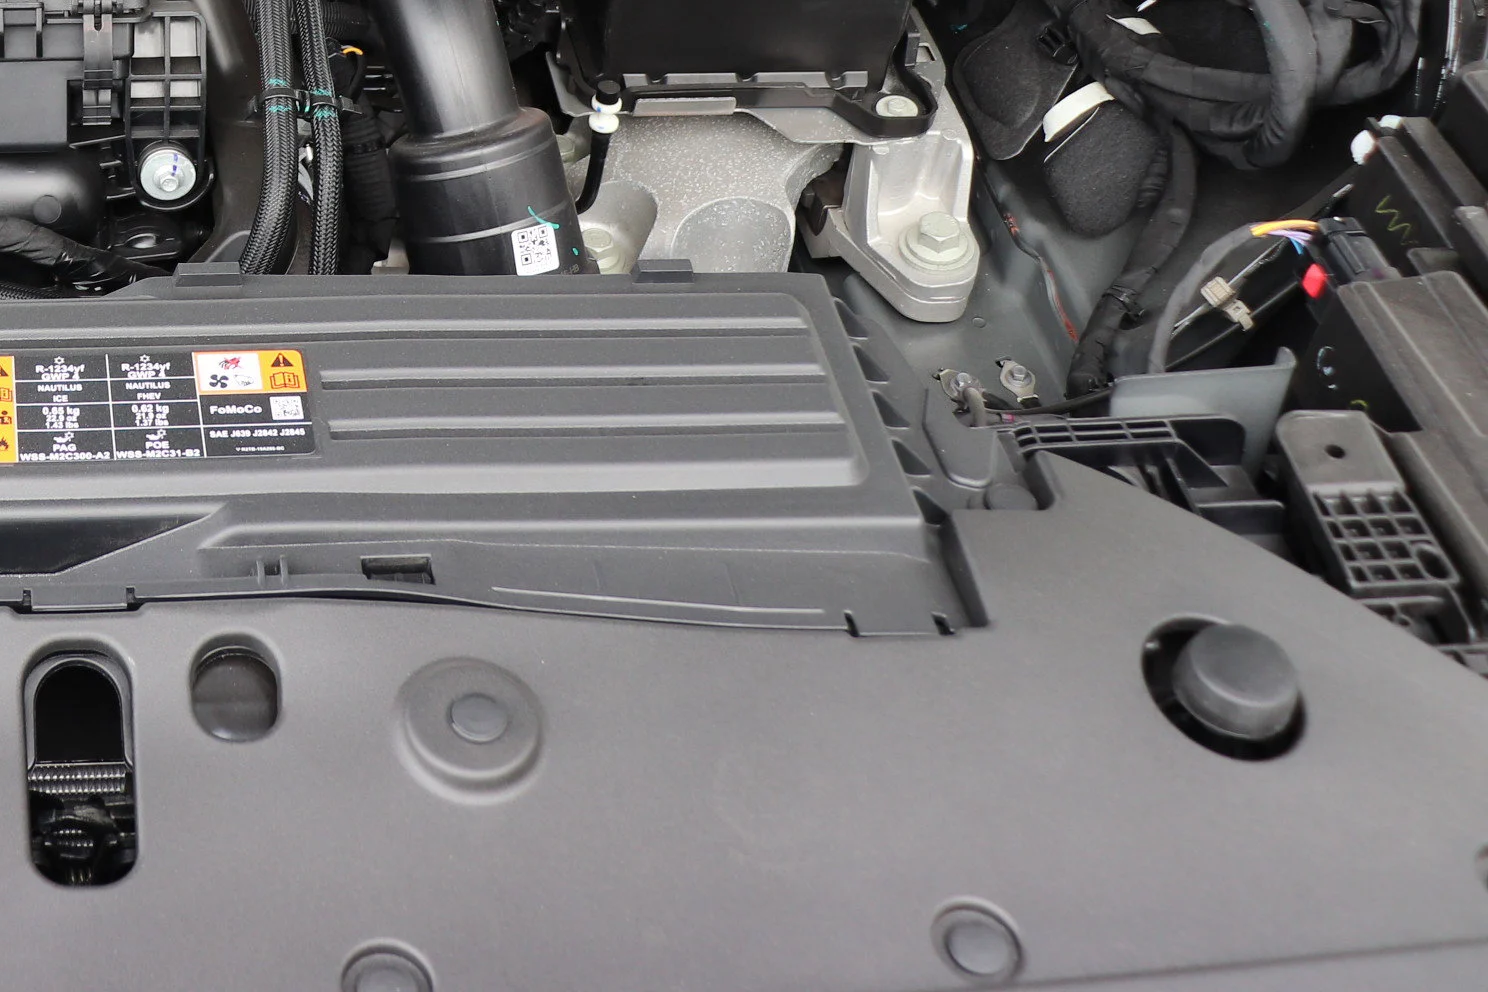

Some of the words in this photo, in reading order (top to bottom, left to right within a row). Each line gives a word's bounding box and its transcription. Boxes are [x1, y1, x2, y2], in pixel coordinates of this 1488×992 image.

[35, 363, 86, 374] R-1234yf
[121, 361, 171, 372] R-1234yf
[41, 372, 70, 381] GWP
[127, 370, 156, 379] GWP
[37, 384, 83, 393] NAUTILUS
[125, 381, 171, 390] NAUTILUS
[53, 394, 69, 403] ICE
[137, 392, 162, 400] FHEV
[42, 407, 65, 416] 0.65
[66, 406, 80, 417] kg
[131, 404, 154, 413] 0.62
[155, 404, 170, 414] kg
[209, 404, 263, 415] FoMoCo
[209, 430, 229, 438] SAE
[230, 429, 251, 438] J639
[252, 428, 278, 437] J2842
[279, 427, 306, 436] J2845
[53, 443, 77, 452] PAG
[145, 440, 170, 449] POE
[20, 451, 111, 461] WSS-M2C300-A2
[116, 448, 201, 459] WSS-M2C31-B2
